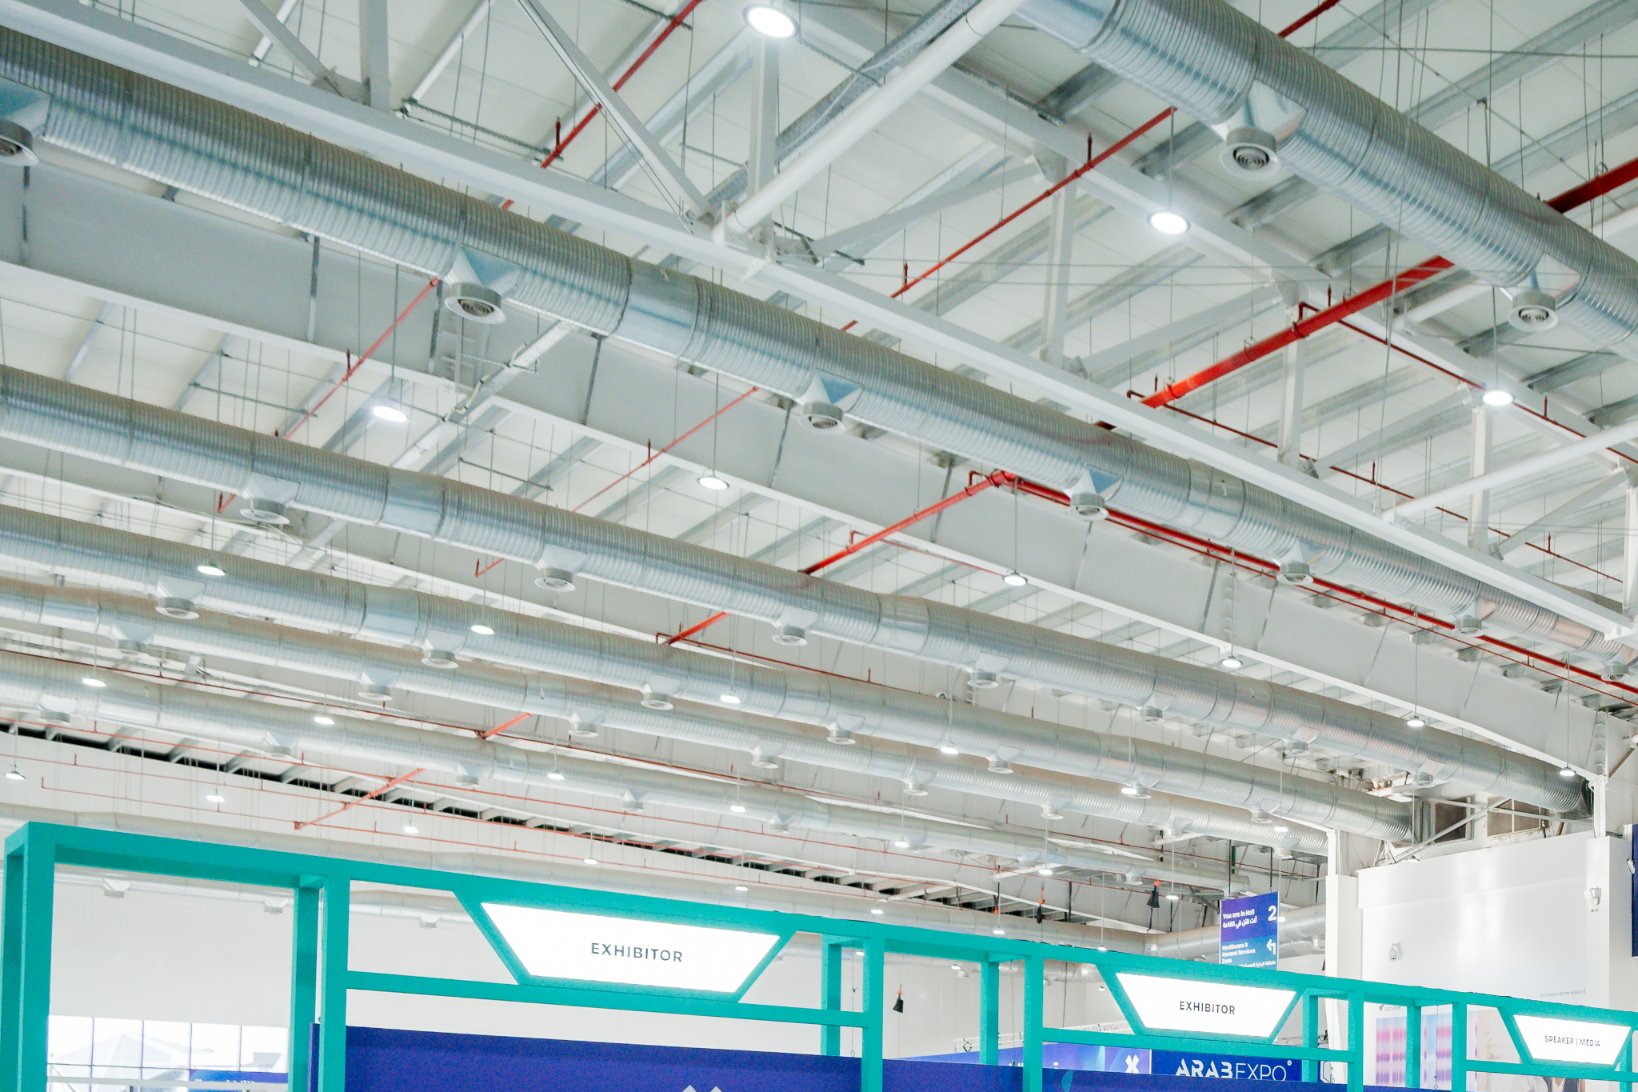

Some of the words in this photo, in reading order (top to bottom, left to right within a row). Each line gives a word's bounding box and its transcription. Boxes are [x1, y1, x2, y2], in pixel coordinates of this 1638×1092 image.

[1267, 905, 1277, 922] 2
[591, 942, 683, 963] EXHIBITOR
[1179, 1000, 1236, 1015] EXHIBITOR
[1544, 1035, 1574, 1045] SPEAKER
[1579, 1038, 1600, 1047] MEDIA
